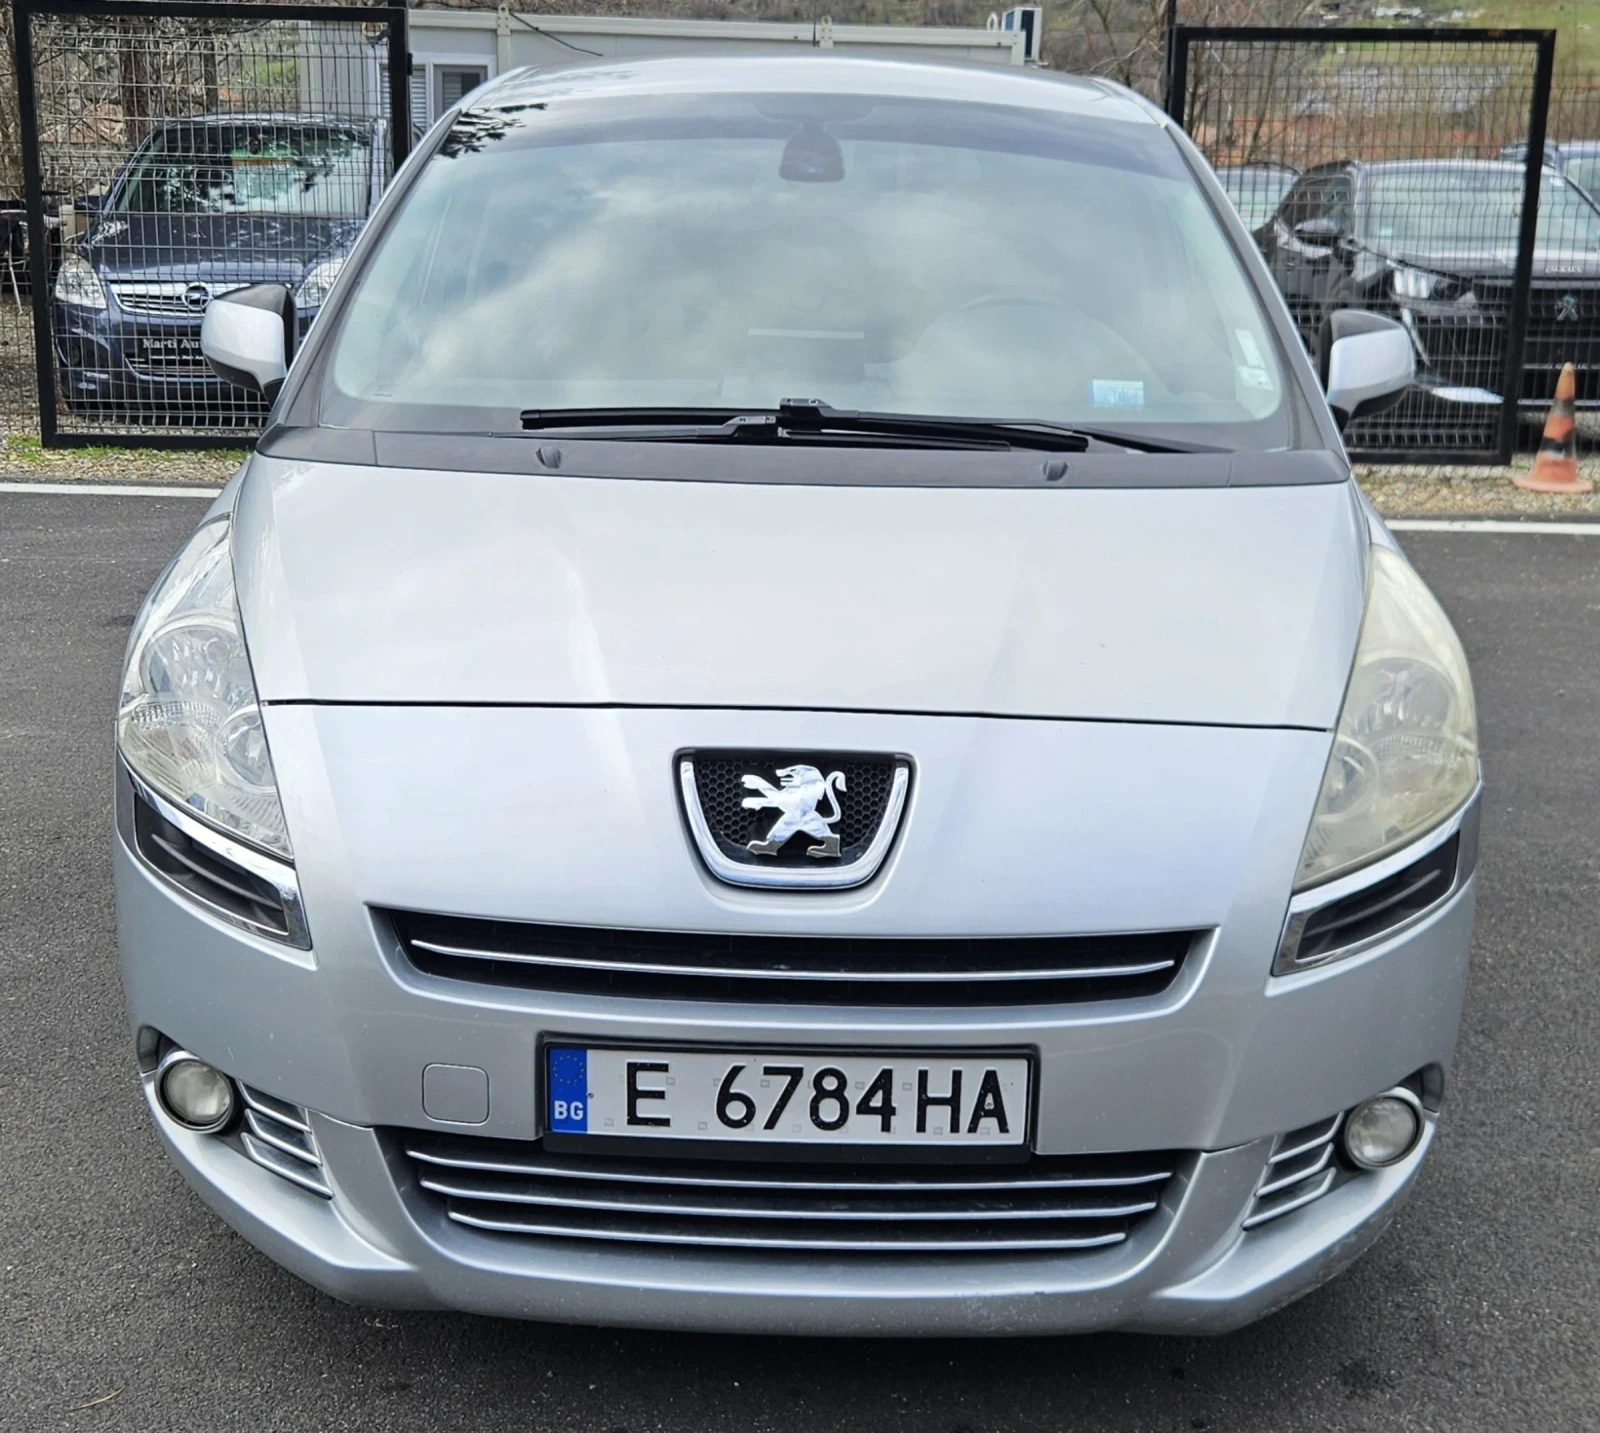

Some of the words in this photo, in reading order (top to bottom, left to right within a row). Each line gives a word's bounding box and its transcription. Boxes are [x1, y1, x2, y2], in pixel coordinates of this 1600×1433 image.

[142, 338, 178, 349] Marti
[626, 1061, 671, 1127] E
[554, 1100, 584, 1121] BG
